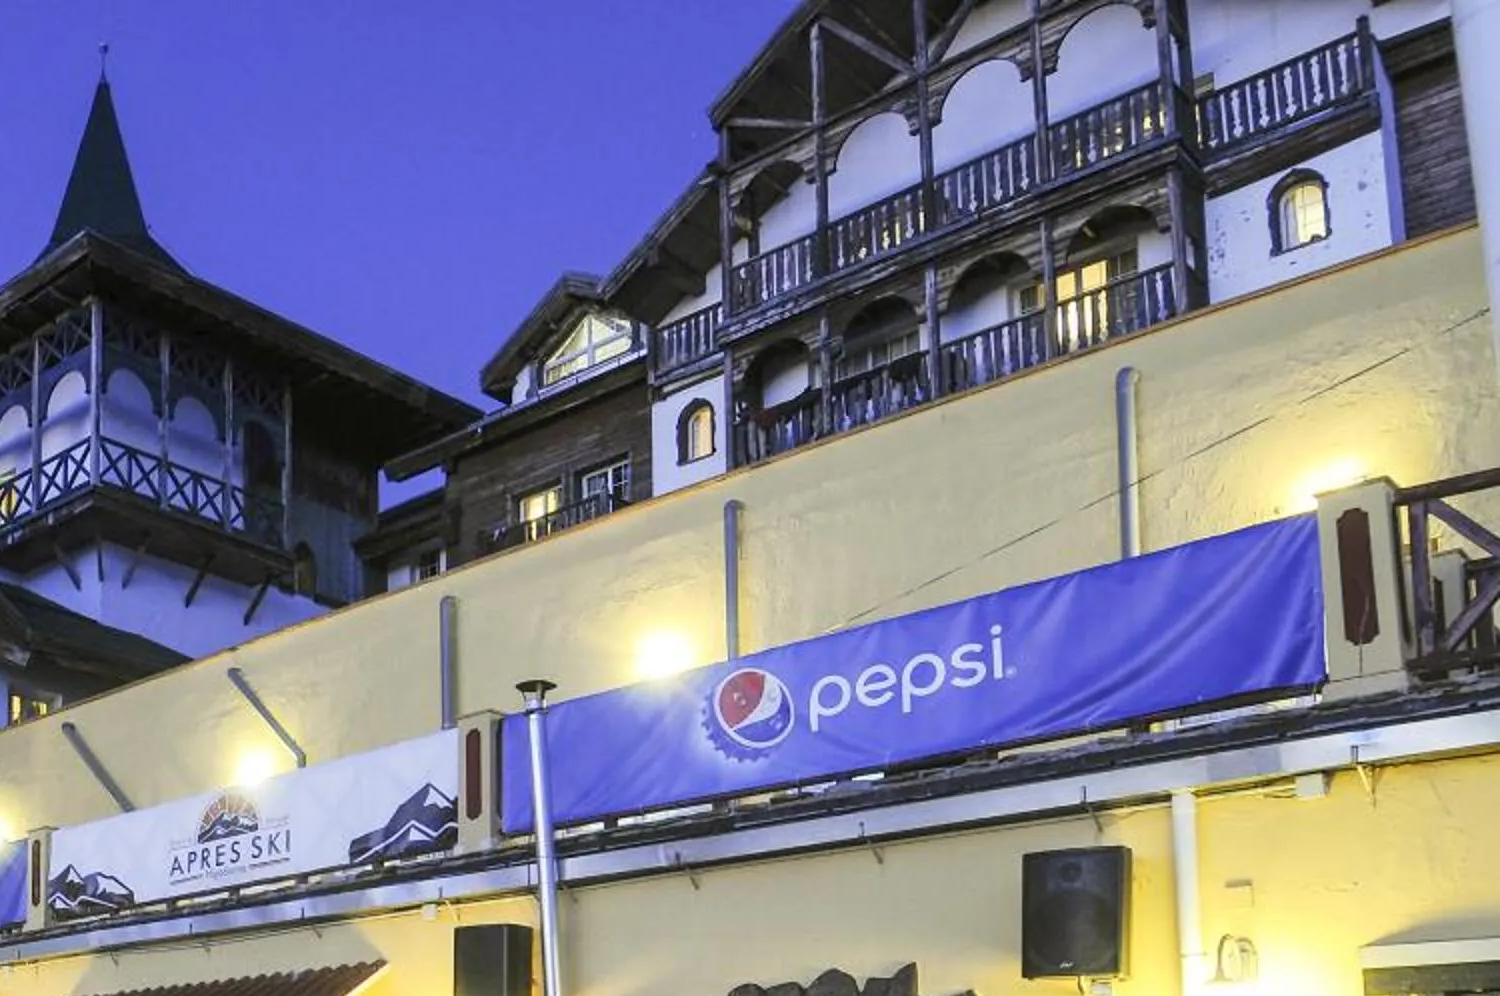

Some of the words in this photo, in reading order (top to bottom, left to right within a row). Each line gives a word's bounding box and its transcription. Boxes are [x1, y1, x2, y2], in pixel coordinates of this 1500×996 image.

[809, 623, 1004, 733] pepsi
[169, 841, 241, 877] APRES
[251, 829, 291, 859] SKI
